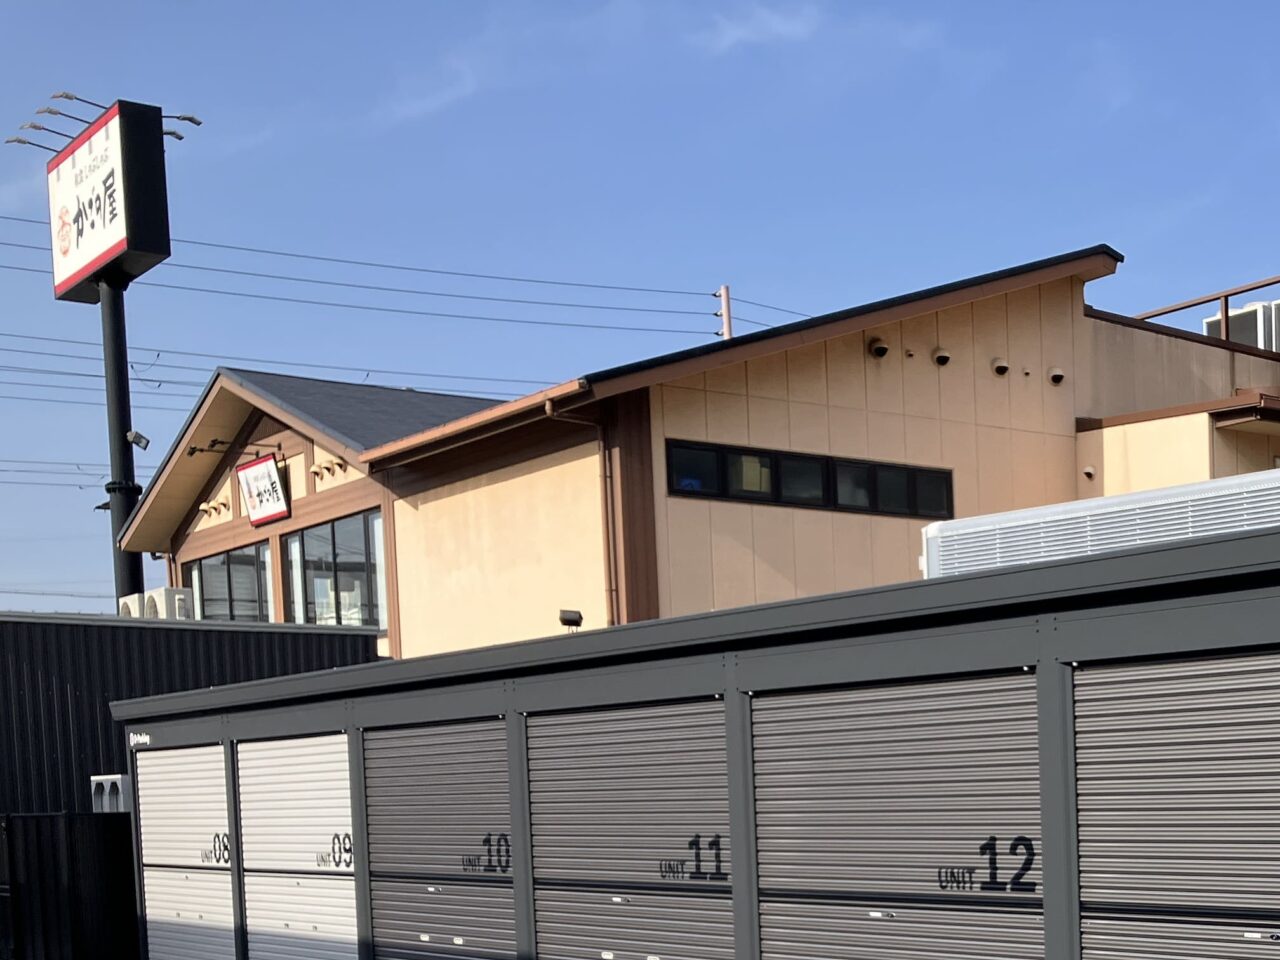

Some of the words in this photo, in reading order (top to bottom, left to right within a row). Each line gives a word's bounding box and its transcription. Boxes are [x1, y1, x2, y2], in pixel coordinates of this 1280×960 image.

[201, 850, 213, 863] UNIT
[213, 833, 230, 863] 08
[316, 853, 332, 867] UNIT
[332, 833, 352, 867] 09
[462, 855, 481, 872] UNIT
[482, 833, 510, 873] 10
[659, 859, 687, 880] UNIT
[688, 834, 729, 880] 11
[938, 866, 976, 890] UNIT
[979, 836, 1037, 892] 12
